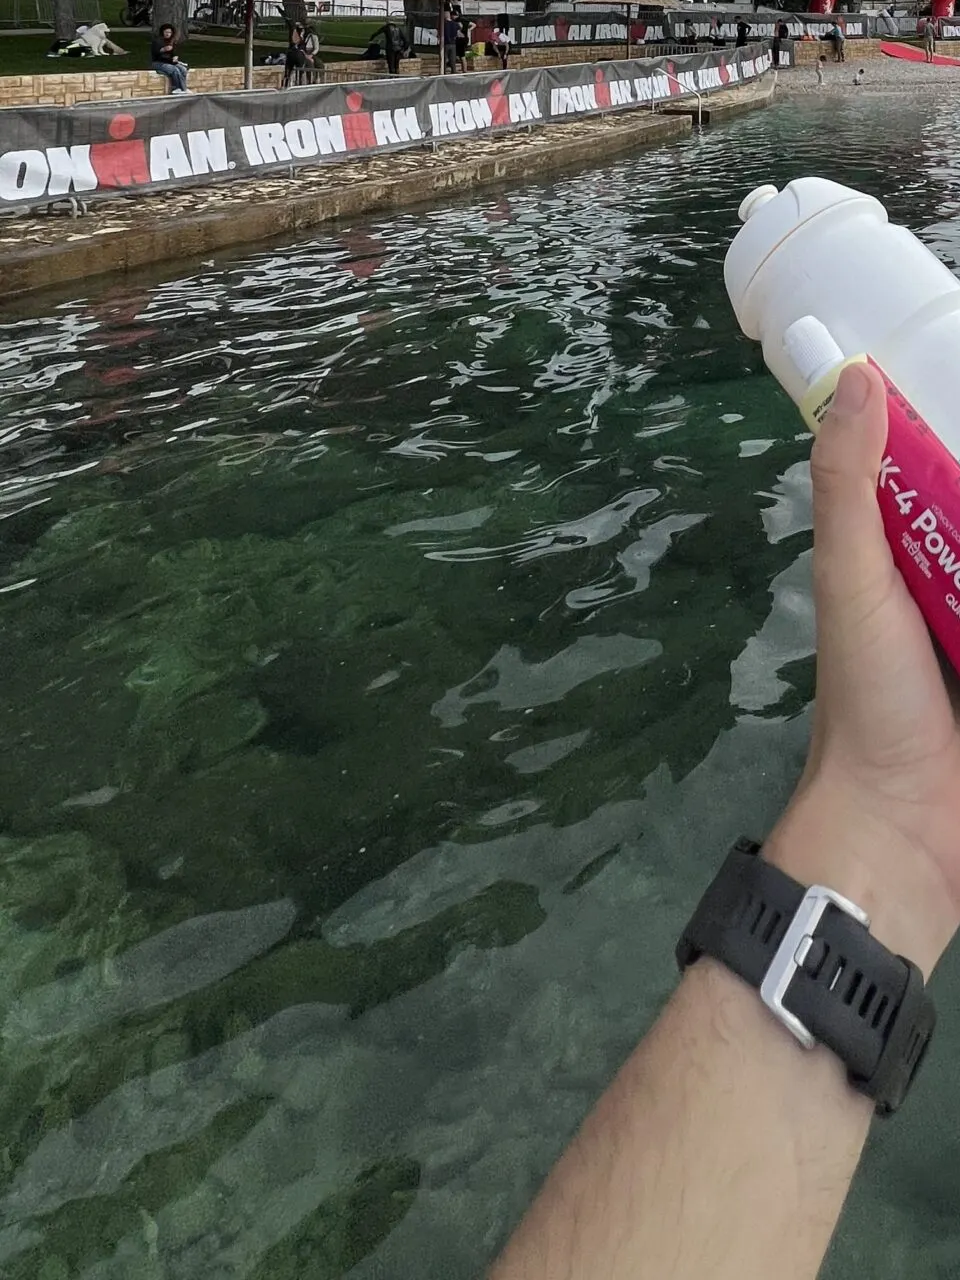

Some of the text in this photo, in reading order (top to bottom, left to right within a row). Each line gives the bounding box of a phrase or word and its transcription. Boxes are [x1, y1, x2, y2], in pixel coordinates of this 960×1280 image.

[240, 91, 422, 166] IRONMAN
[429, 79, 541, 137] IRONMAN
[551, 68, 632, 116] IRONMAN
[879, 456, 917, 515] K-4
